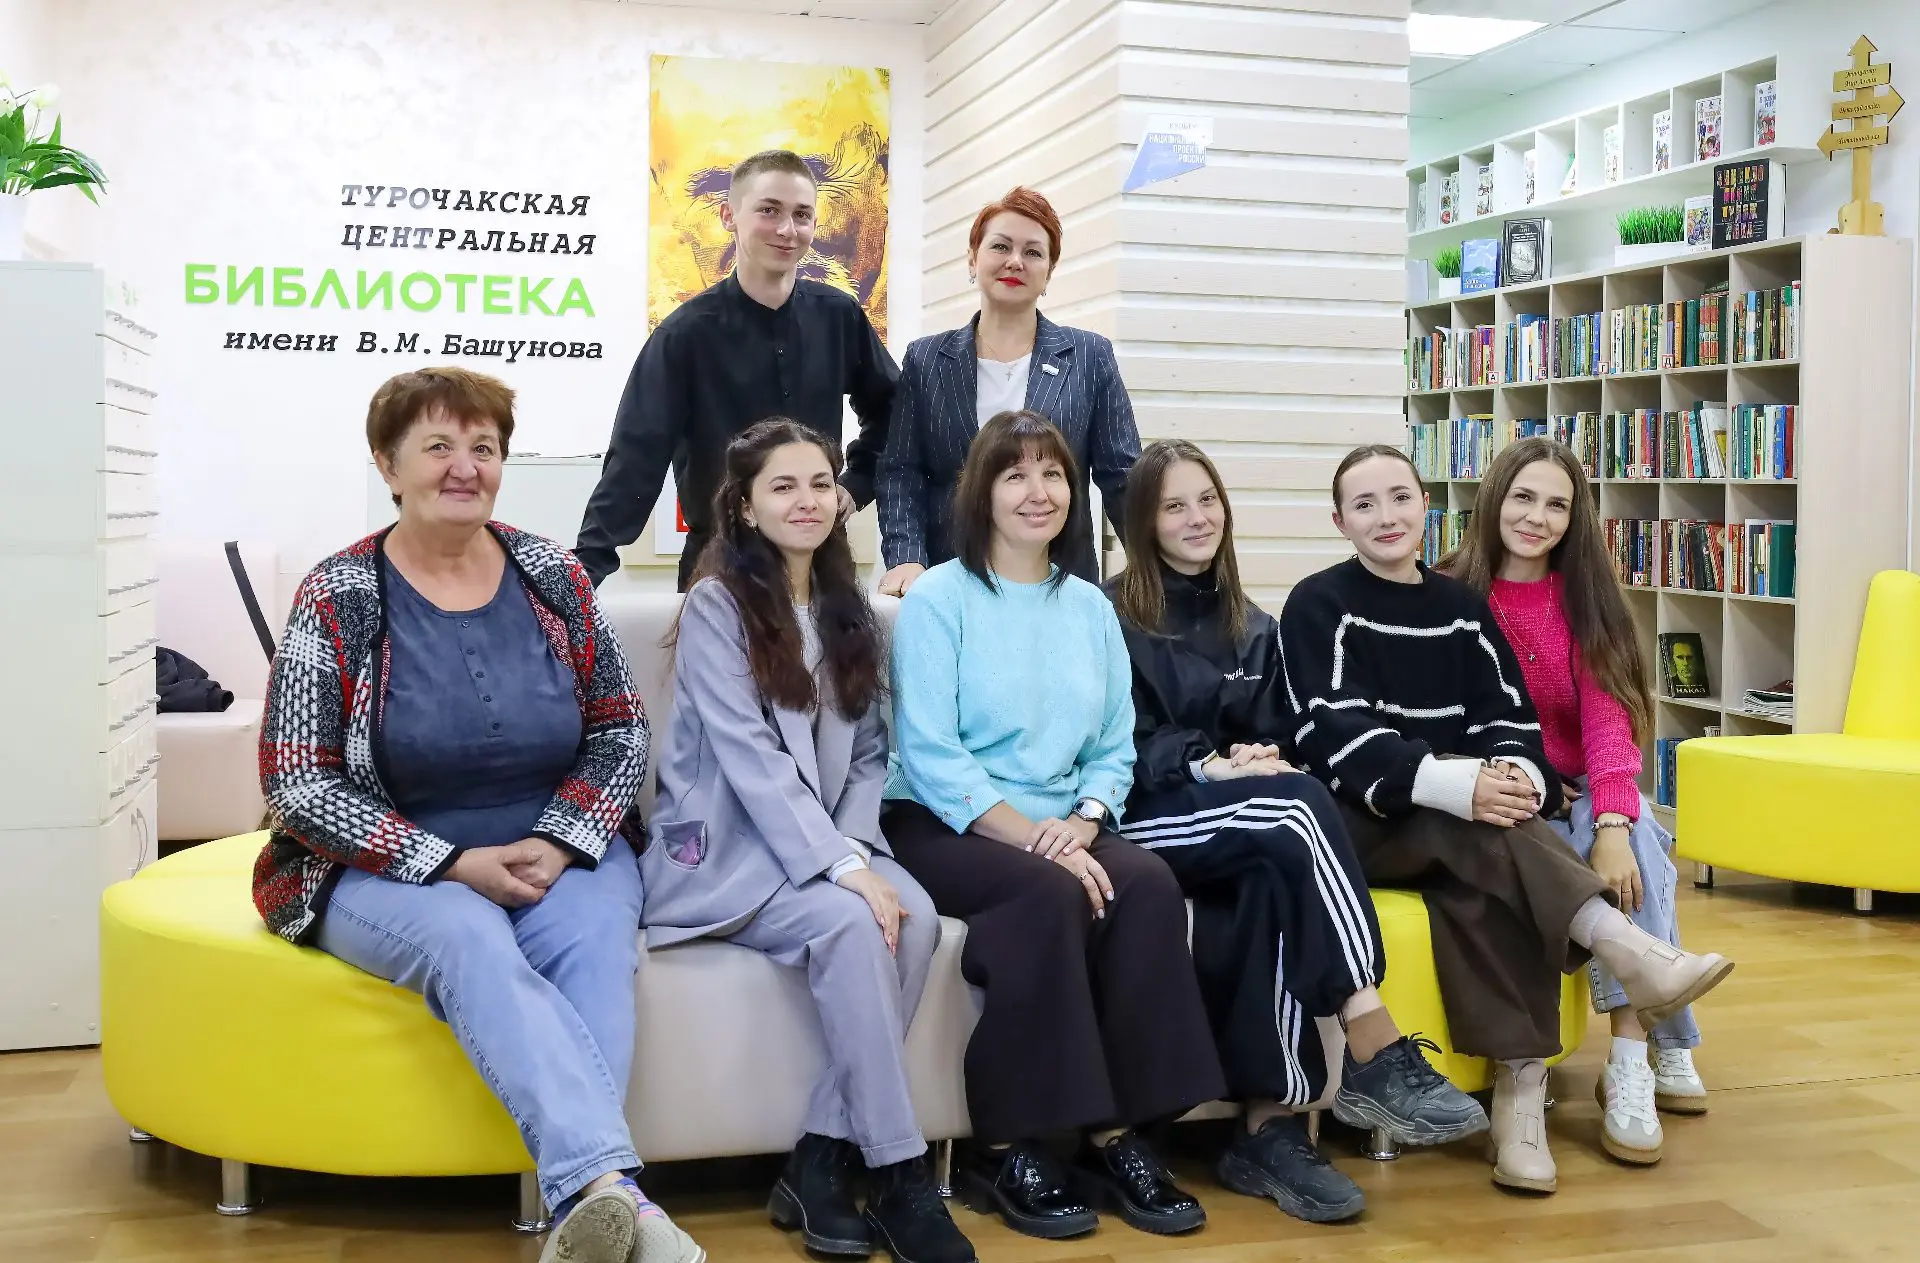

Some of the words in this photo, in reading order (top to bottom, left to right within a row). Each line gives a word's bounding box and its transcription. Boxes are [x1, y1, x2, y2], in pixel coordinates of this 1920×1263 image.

[341, 185, 591, 216] ТУРОЧАКСКАЯ
[341, 225, 596, 255] ЦЕНТРАЛЬНАЯ
[184, 263, 596, 317] БИБЛИОТЕКА
[223, 332, 339, 352] имени
